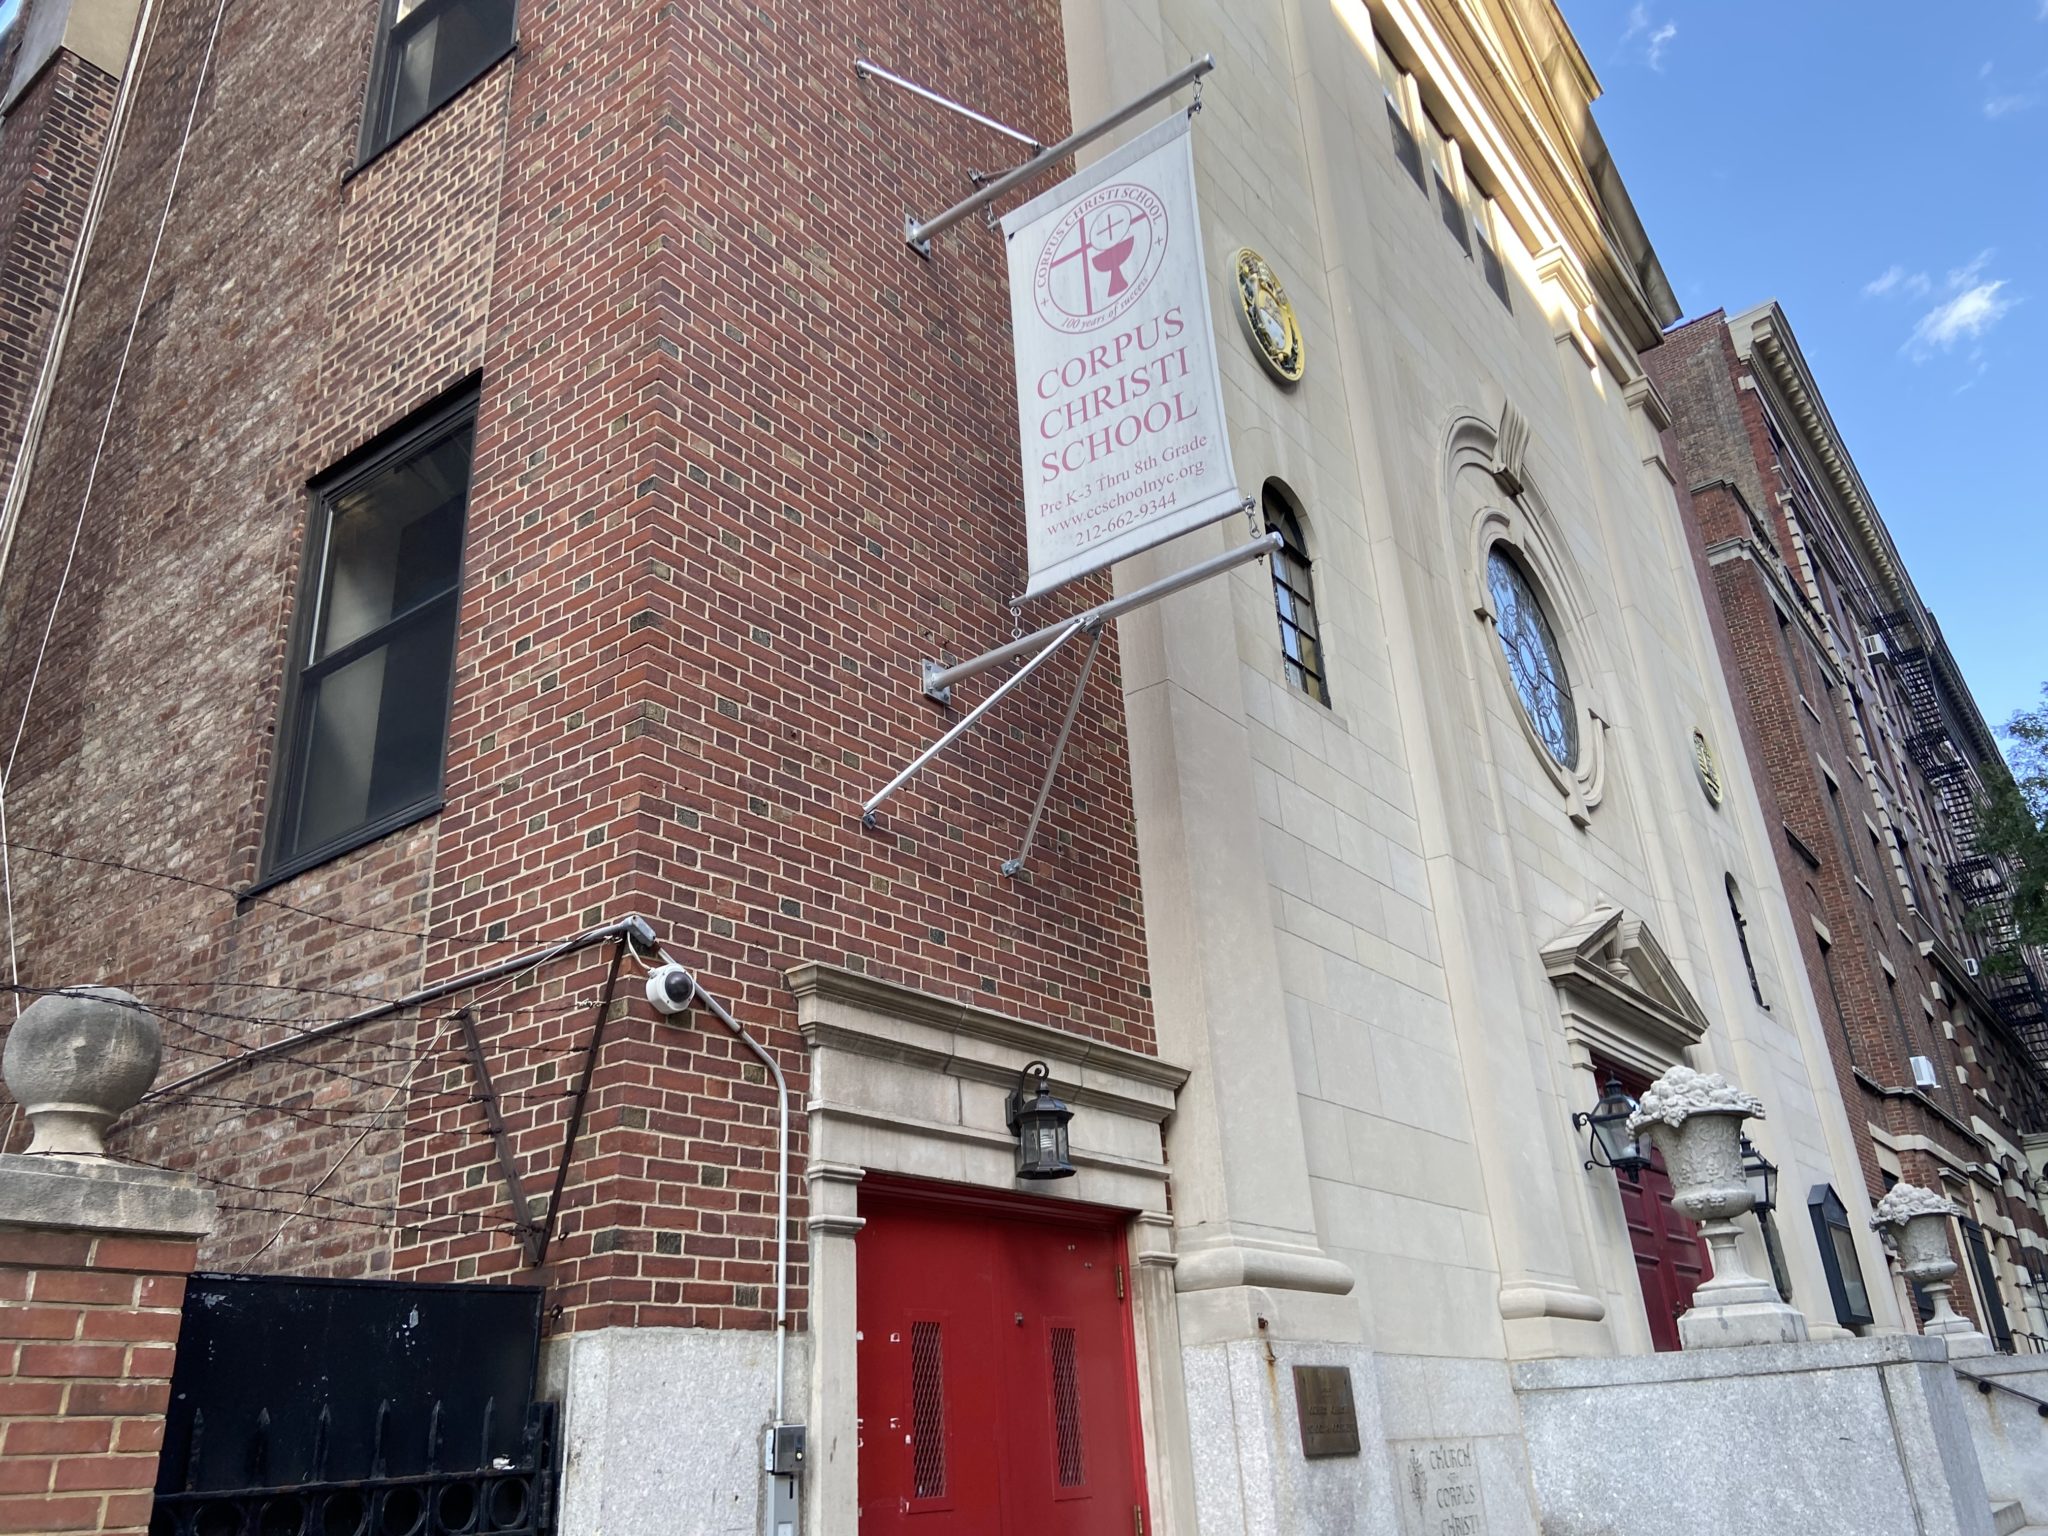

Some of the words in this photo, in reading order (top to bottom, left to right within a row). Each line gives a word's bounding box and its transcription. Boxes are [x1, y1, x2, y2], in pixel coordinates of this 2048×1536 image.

[1037, 229, 1065, 288] CORPUS
[1065, 188, 1119, 227] CHRISTI
[1121, 187, 1163, 225] SCHOOL
[1061, 317, 1081, 329] 100
[1081, 315, 1105, 331] years
[1108, 302, 1119, 316] of
[1120, 277, 1149, 309] success
[1037, 306, 1185, 400] CORPUS
[1040, 346, 1190, 440] CHRISTI
[1040, 500, 1063, 518] Pre
[1066, 484, 1092, 506] K-3
[1096, 469, 1131, 492] Thru
[1135, 455, 1158, 475] 8th
[1162, 435, 1208, 462] Grade
[1041, 392, 1198, 484] SCHOOL
[1047, 461, 1205, 536] www.ccschoolnyc.org
[1076, 492, 1178, 547] 212-662-9344
[1429, 1442, 1472, 1470] CHURCH
[1437, 1484, 1476, 1509] CORPUS
